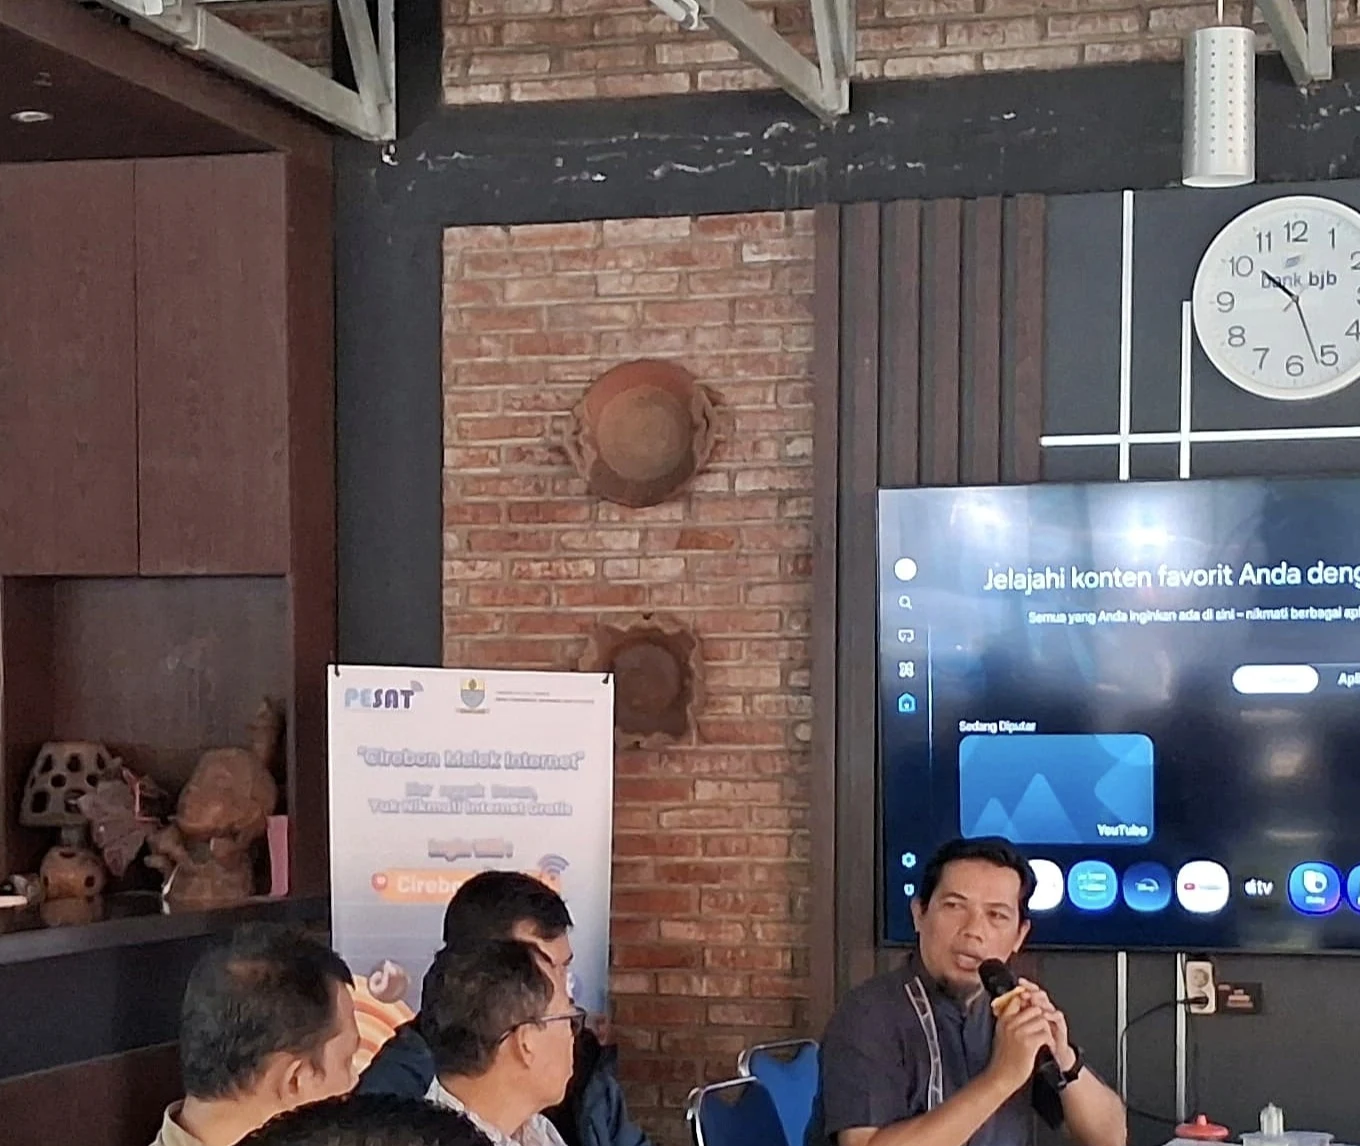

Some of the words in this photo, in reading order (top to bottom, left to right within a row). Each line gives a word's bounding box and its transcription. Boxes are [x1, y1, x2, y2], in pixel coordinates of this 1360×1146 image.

[1256, 231, 1272, 253] 11
[1283, 220, 1309, 243] 12
[1328, 227, 1336, 250] 1
[1229, 255, 1254, 277] 10
[1260, 271, 1304, 289] bank
[1308, 270, 1337, 290] bjb
[1216, 291, 1235, 313] 9
[1227, 326, 1246, 348] 8
[1252, 348, 1270, 370] 7
[1285, 354, 1305, 376] 6
[1320, 344, 1339, 367] 5
[984, 565, 1066, 595] Jelajahi
[1071, 566, 1152, 589] konten
[1157, 563, 1234, 587] favorit
[1238, 560, 1302, 586] Anda
[1028, 611, 1067, 624] Semua
[1068, 613, 1097, 625] yang
[1098, 610, 1129, 623] Anda
[1178, 610, 1201, 622] ada
[1201, 608, 1214, 621] di
[1245, 607, 1289, 621] nikmati
[1290, 606, 1341, 622] berbagai
[344, 688, 415, 709] PESAT
[959, 720, 997, 734] Sedang
[998, 720, 1036, 734] Diputar
[443, 750, 501, 770] Melek
[1097, 823, 1148, 837] YouTube
